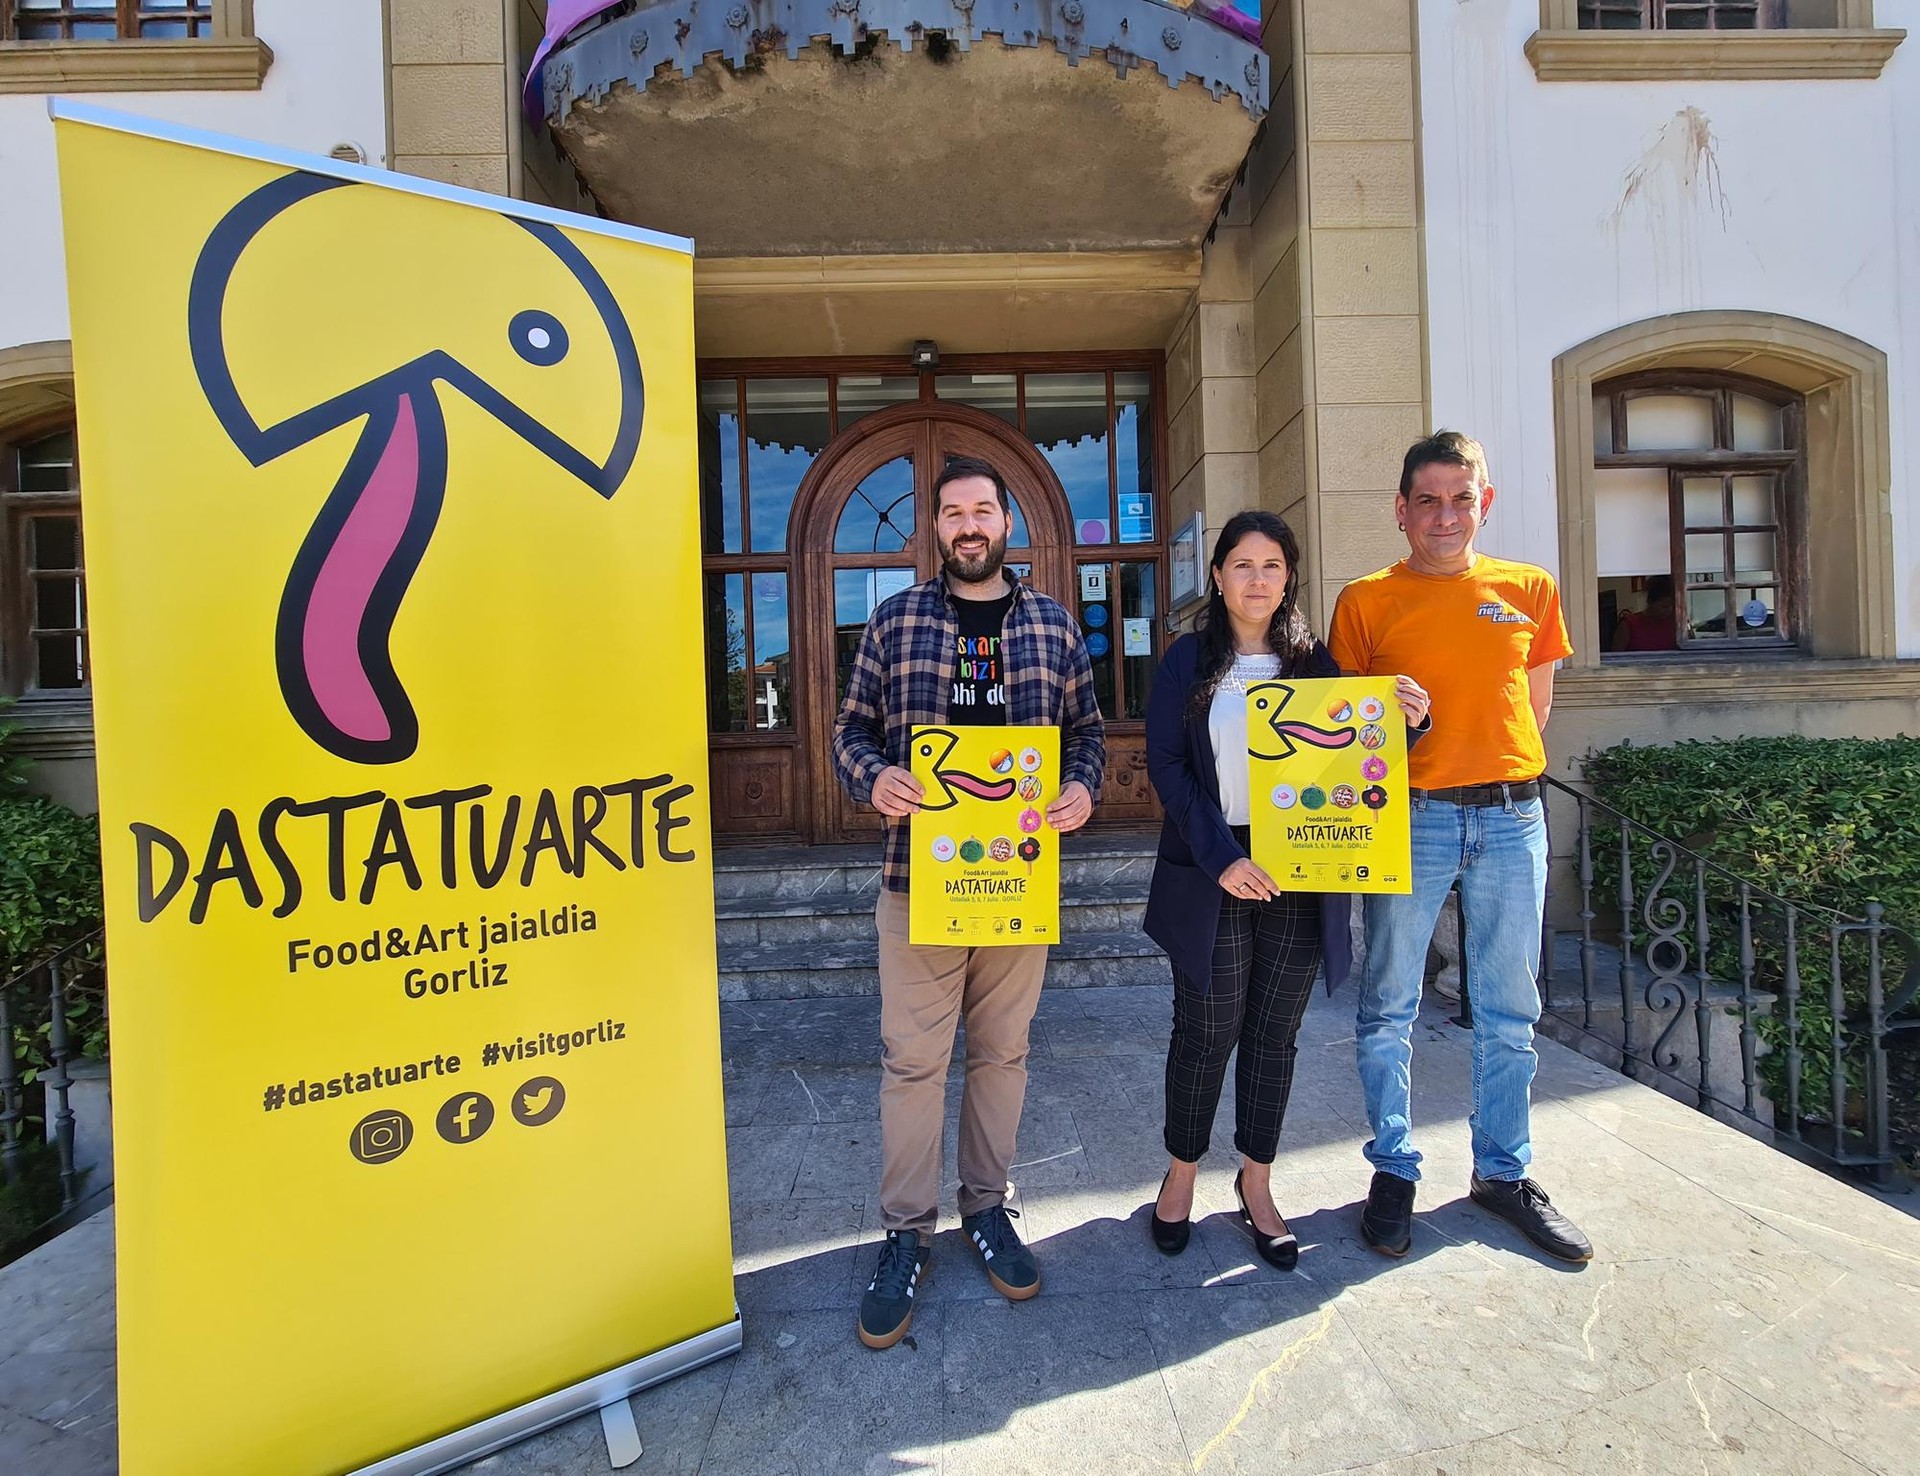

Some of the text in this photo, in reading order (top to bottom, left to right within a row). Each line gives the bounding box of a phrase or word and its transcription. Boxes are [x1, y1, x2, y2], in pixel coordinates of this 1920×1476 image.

[957, 636, 1003, 656] skar
[960, 658, 996, 680] bizi
[129, 773, 696, 925] DASTATUARTE
[1287, 825, 1373, 842] DASTATUARTE
[945, 877, 1027, 895] DASTATUARTE
[287, 904, 598, 974] Food&Art jaialdia
[403, 960, 509, 1000] Gorliz
[263, 1018, 627, 1112] #dastatuarte #visitgorliz
